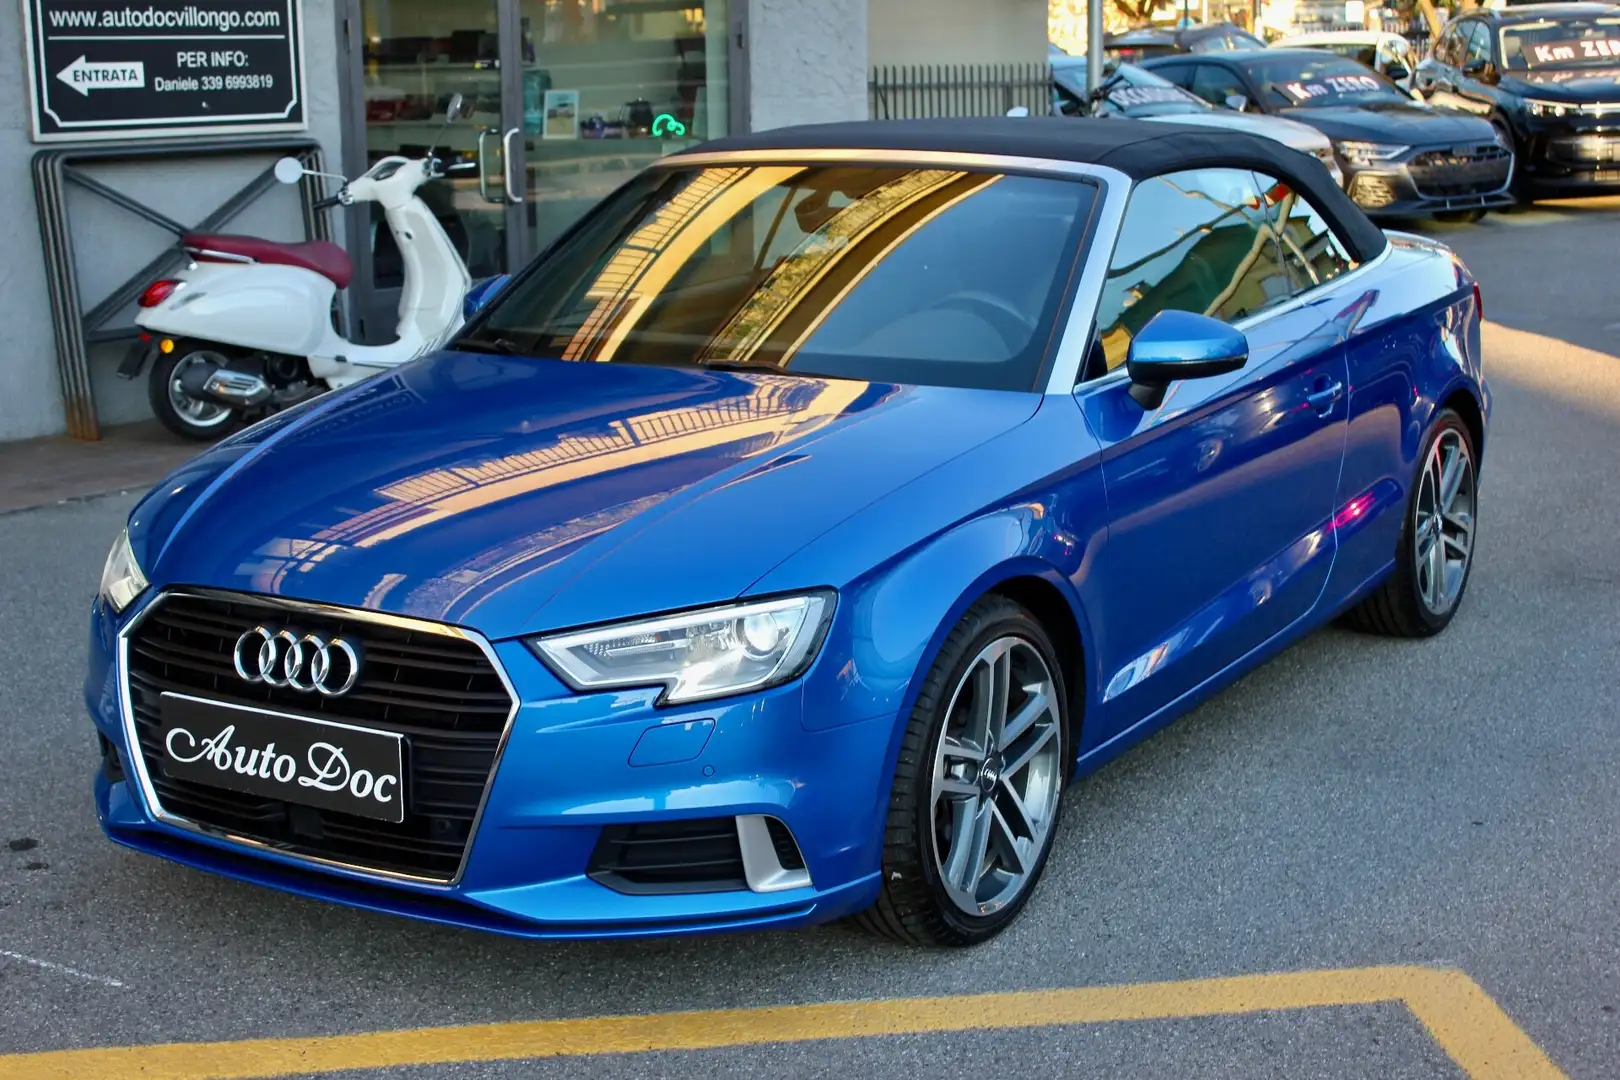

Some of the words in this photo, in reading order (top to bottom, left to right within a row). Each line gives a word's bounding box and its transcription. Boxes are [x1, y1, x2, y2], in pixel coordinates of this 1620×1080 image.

[49, 7, 280, 32] www.autodocvillongo.com
[177, 51, 208, 68] PER
[211, 50, 249, 67] INFO:
[1534, 44, 1575, 62] Km
[73, 68, 138, 83] ENTRATA
[154, 76, 199, 92] Daniele
[201, 75, 223, 90] 339
[225, 74, 273, 89] 6993819
[1286, 82, 1328, 99] Km
[1324, 76, 1379, 91] ZERO
[166, 725, 296, 782] Auto
[298, 742, 397, 802] Doc
